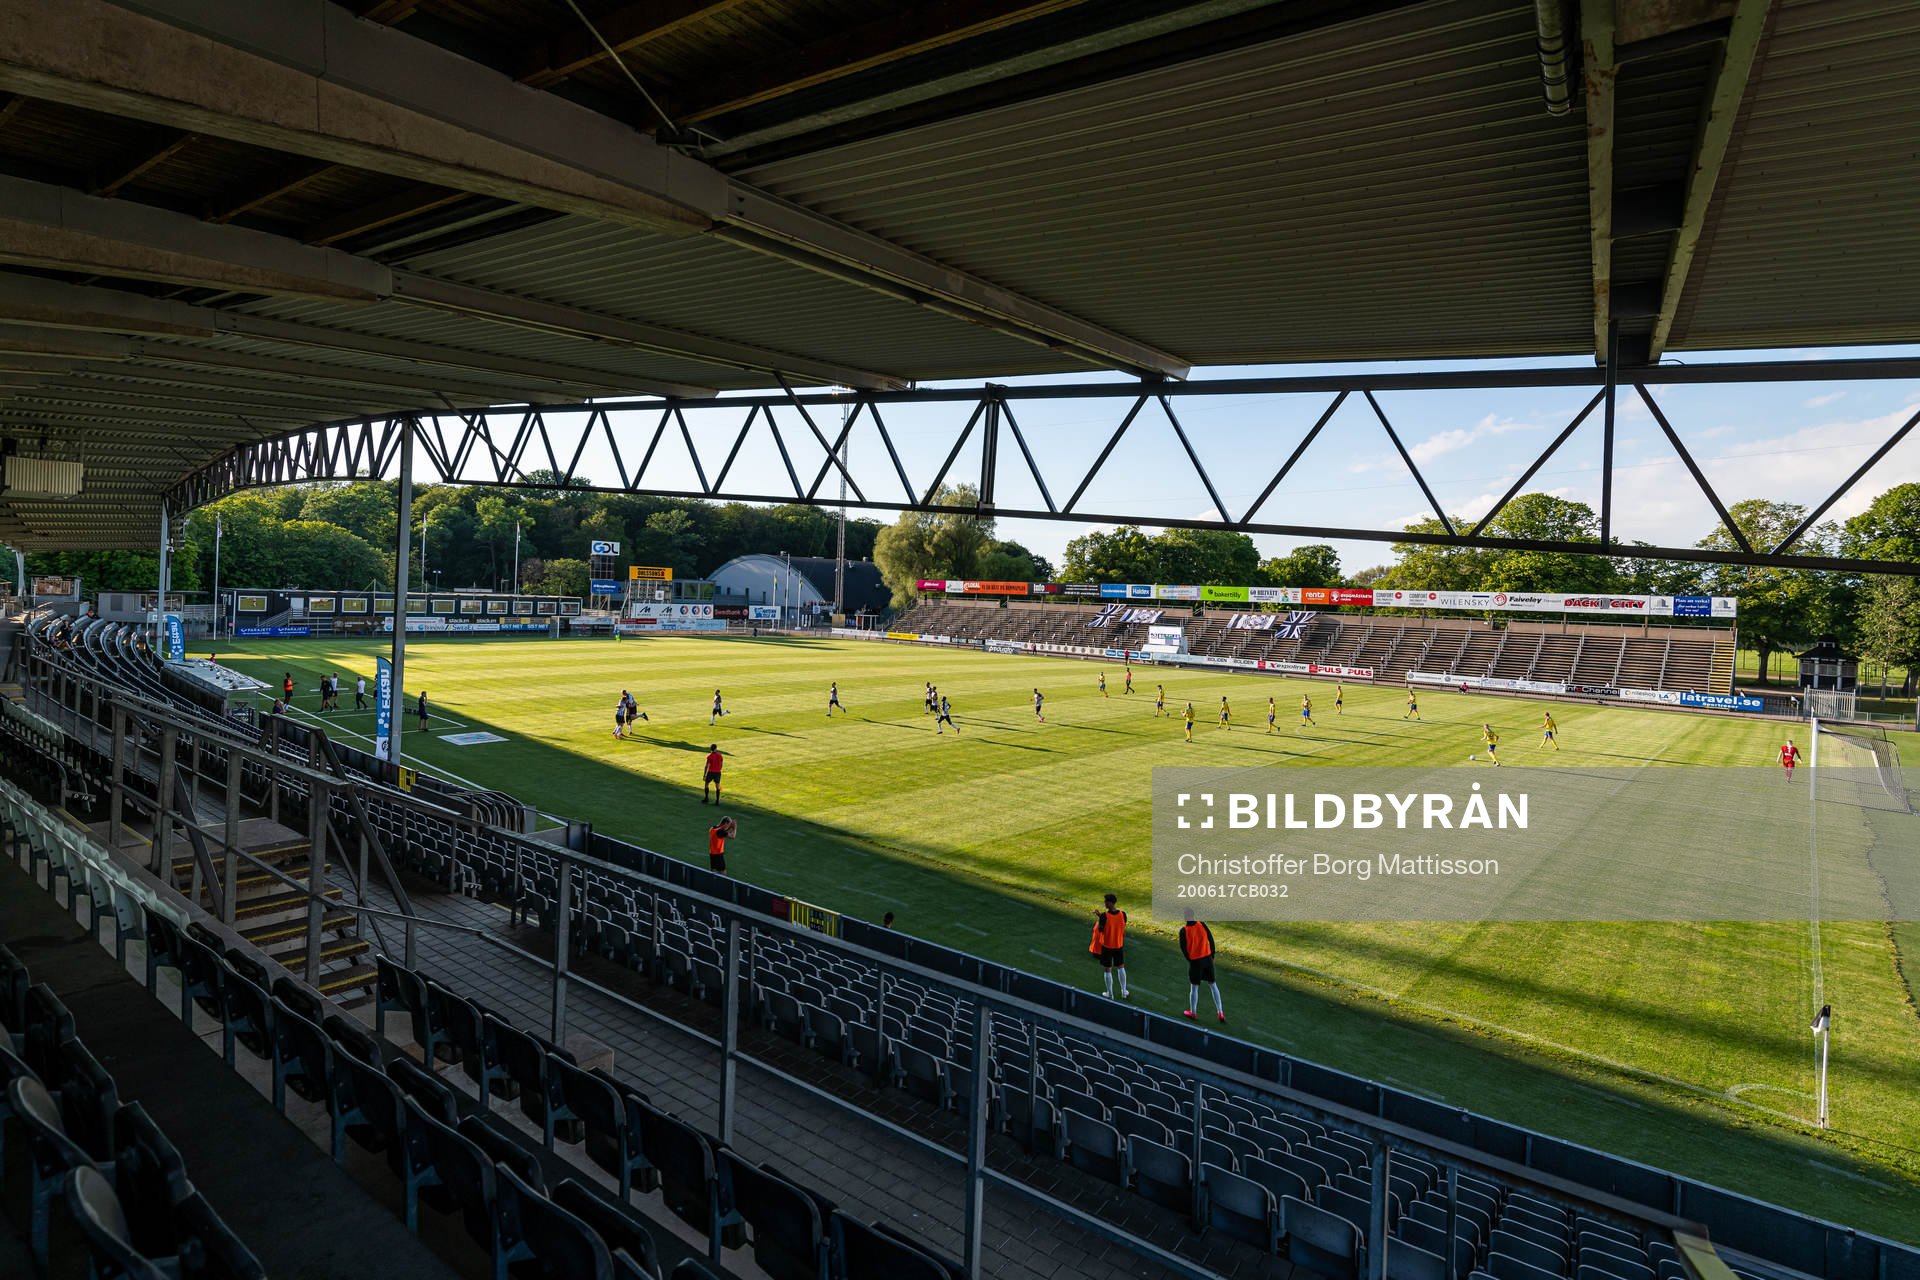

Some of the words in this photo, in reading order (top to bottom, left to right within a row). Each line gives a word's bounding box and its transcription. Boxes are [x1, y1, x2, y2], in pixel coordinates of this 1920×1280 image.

[593, 542, 619, 554] GDL
[1132, 587, 1150, 595] Haldex
[1214, 591, 1242, 599] bakertilly
[1509, 596, 1542, 604] Faiveley
[1318, 666, 1342, 674] PULS
[1347, 668, 1373, 677] PULS
[1682, 692, 1761, 707] latravel.se
